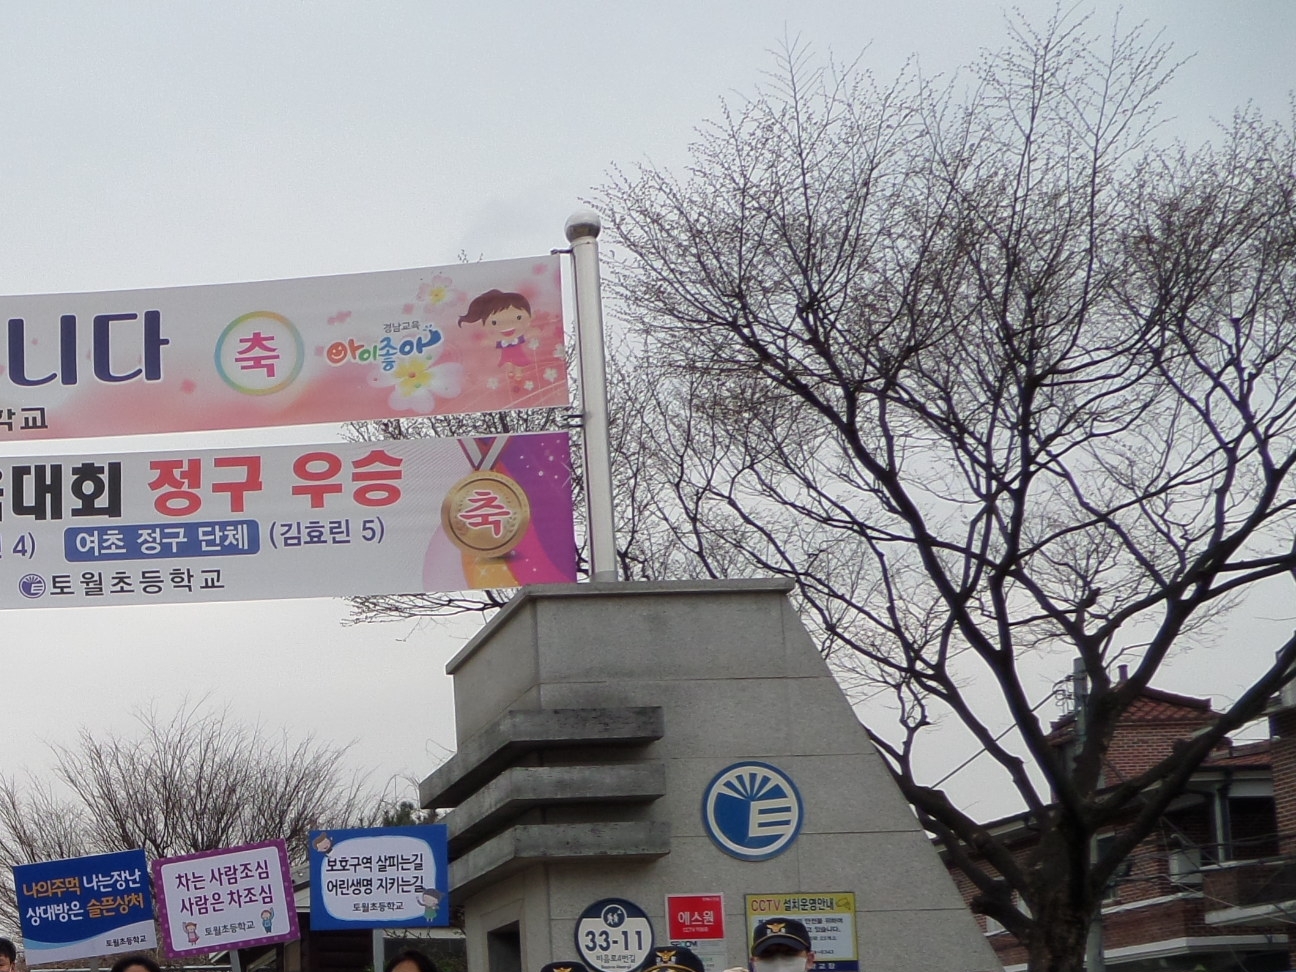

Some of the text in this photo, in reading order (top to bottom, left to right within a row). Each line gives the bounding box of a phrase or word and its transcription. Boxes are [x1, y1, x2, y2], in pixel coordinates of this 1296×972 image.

[383, 320, 421, 333] 경남교육
[233, 332, 282, 378] 축
[326, 329, 442, 371] 아이좋아
[146, 456, 264, 517] 정구
[290, 449, 405, 508] 우승
[458, 489, 522, 540] 축
[11, 533, 37, 562] 4)
[74, 524, 250, 557] 여초 정구 단체
[268, 516, 386, 552] (김효린 5)
[49, 568, 225, 597] 토월초등학교
[175, 863, 271, 891] 차는 사람조심
[325, 852, 424, 874] 보호구역 살피는길
[22, 870, 141, 898] 나의주먹 나는장난
[325, 873, 424, 897] 어린생명 지키는길
[25, 893, 144, 925] 상대방은 슬픈상처
[180, 884, 275, 915] 사람은 차조심
[352, 901, 405, 913] 토월초등학교
[751, 898, 834, 912] CCTV 설치운영안내
[204, 920, 256, 936] 토월초등학교
[677, 910, 714, 926] 에스원
[105, 934, 147, 947] 토월초등학교
[585, 930, 643, 952] 33-11
